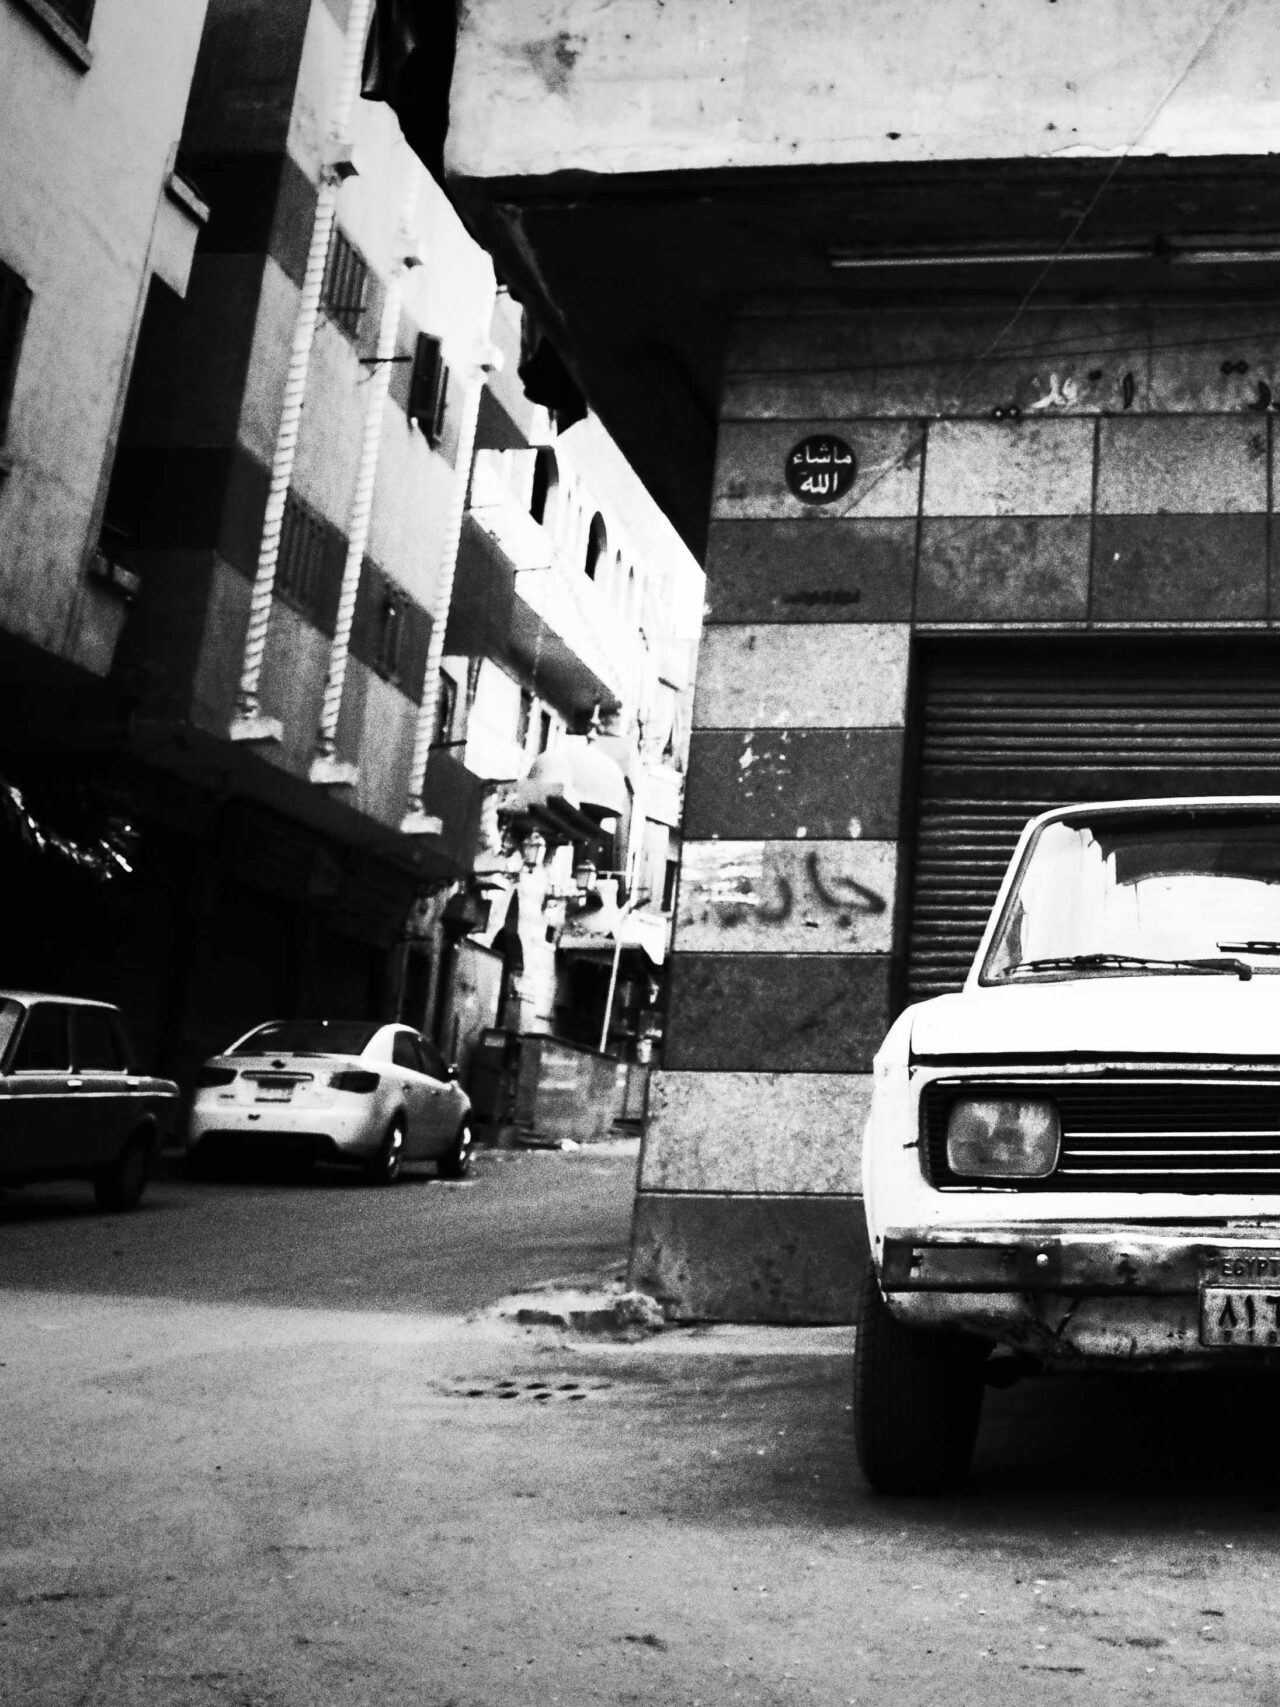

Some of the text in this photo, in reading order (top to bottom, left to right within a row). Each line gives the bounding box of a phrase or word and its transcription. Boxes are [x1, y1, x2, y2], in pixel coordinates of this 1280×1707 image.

[792, 443, 853, 466] ماشاء
[799, 470, 839, 495] الله
[1221, 1256, 1280, 1277] EGYPT
